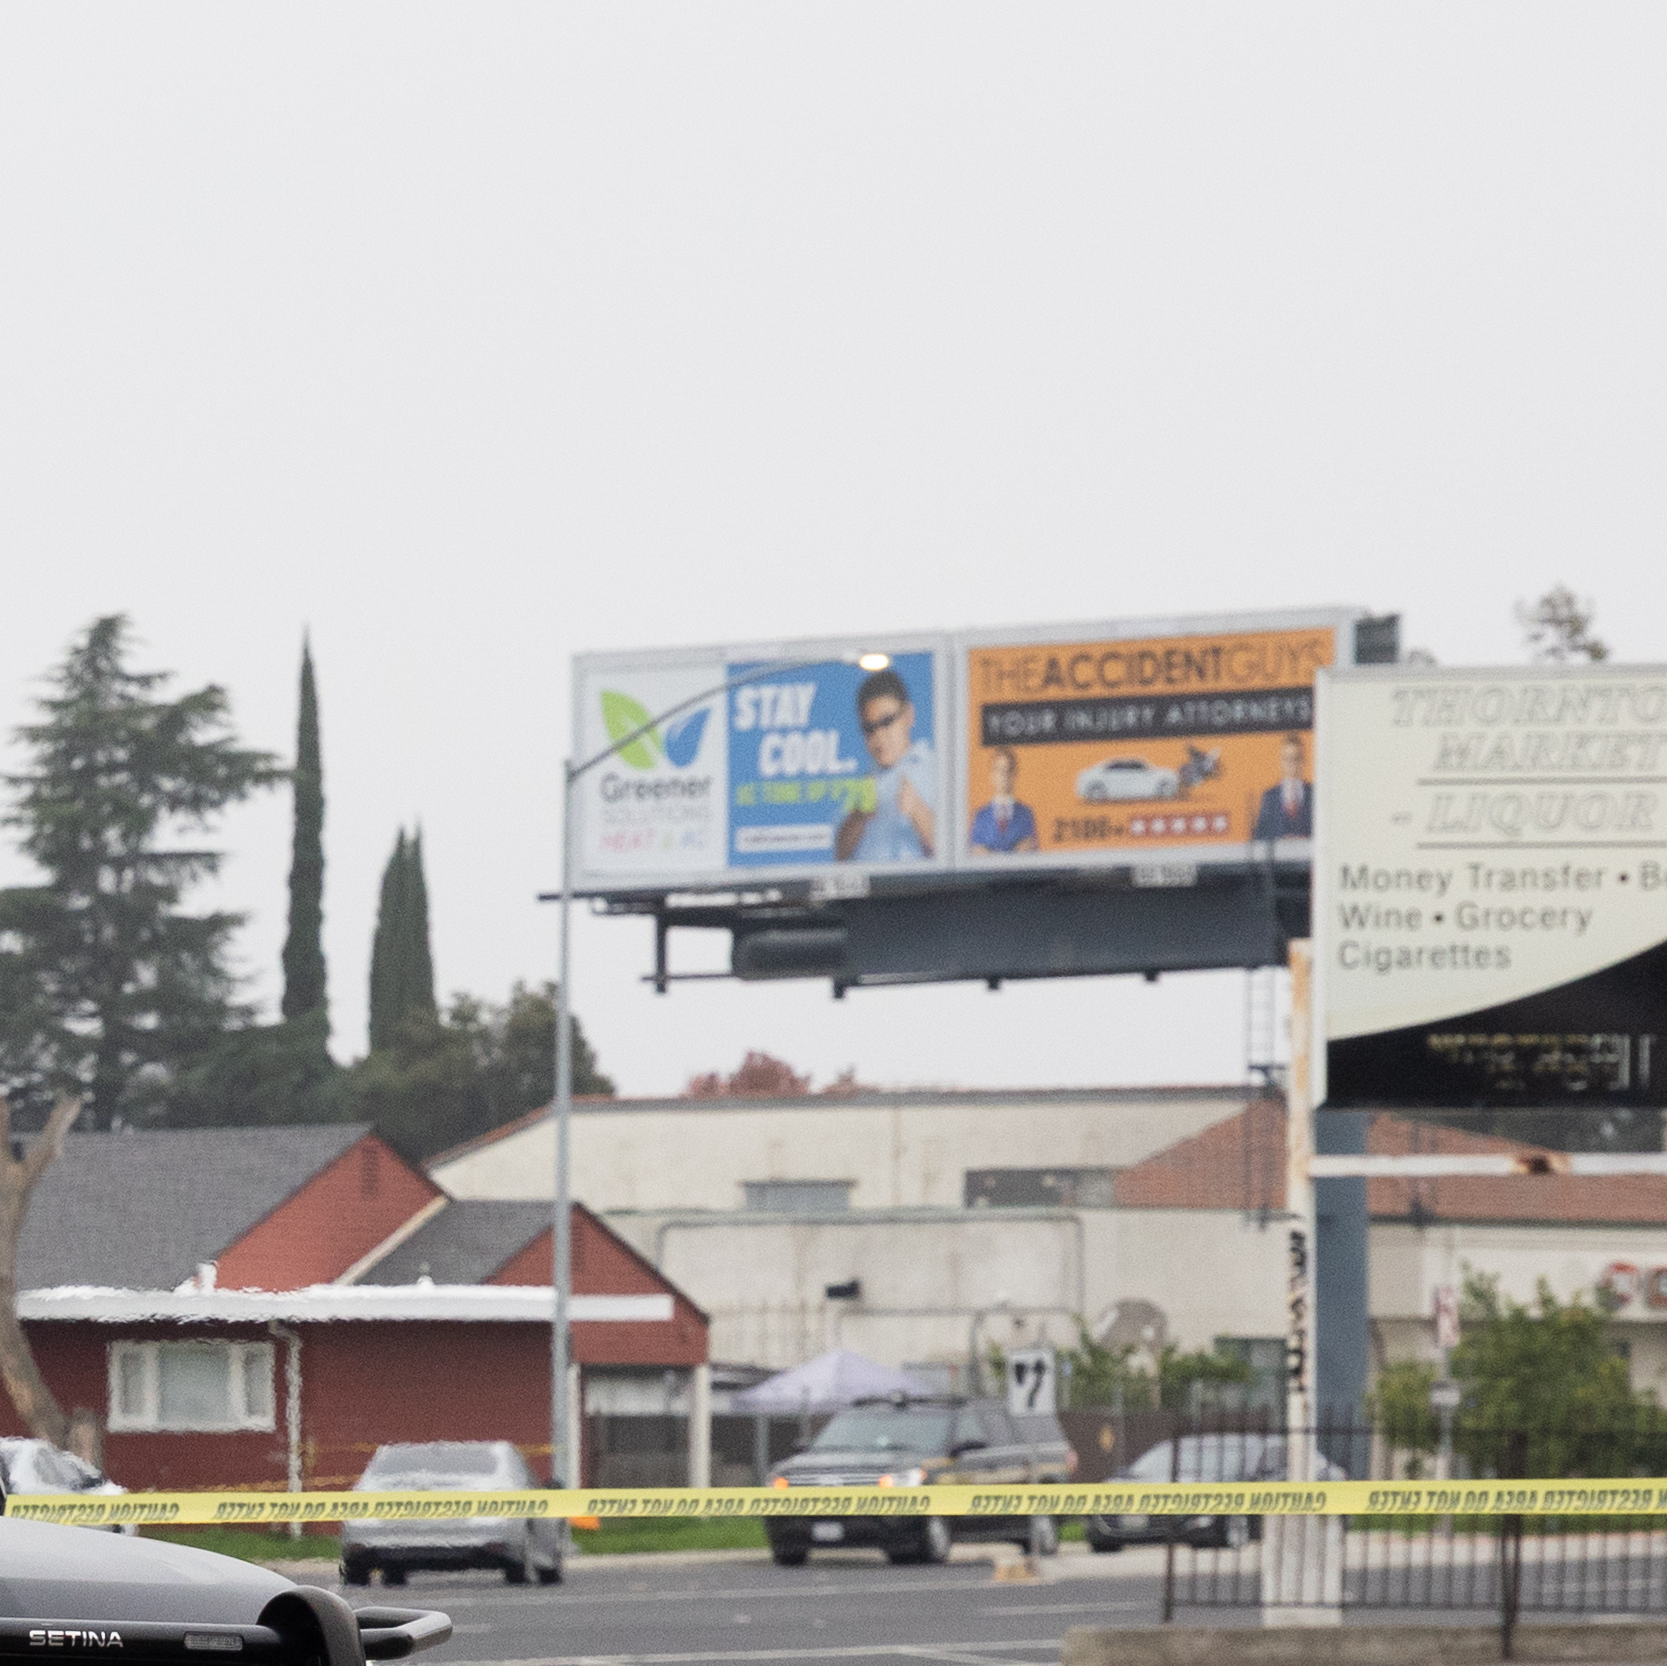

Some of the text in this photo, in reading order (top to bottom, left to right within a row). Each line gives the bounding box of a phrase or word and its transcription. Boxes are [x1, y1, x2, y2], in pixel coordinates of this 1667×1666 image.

[734, 682, 817, 732] STAY
[989, 694, 1312, 738] YOUR INJURY ATTORNEYS
[758, 729, 858, 778] COOL.
[599, 774, 712, 804] Greener
[1424, 791, 1660, 837] LIQUOR
[1338, 862, 1453, 898] Money
[1466, 861, 1605, 891] Transfer
[1338, 900, 1593, 935] Wine Grocery
[1336, 940, 1512, 975] Cigarettes
[29, 1629, 124, 1648] SETINA
